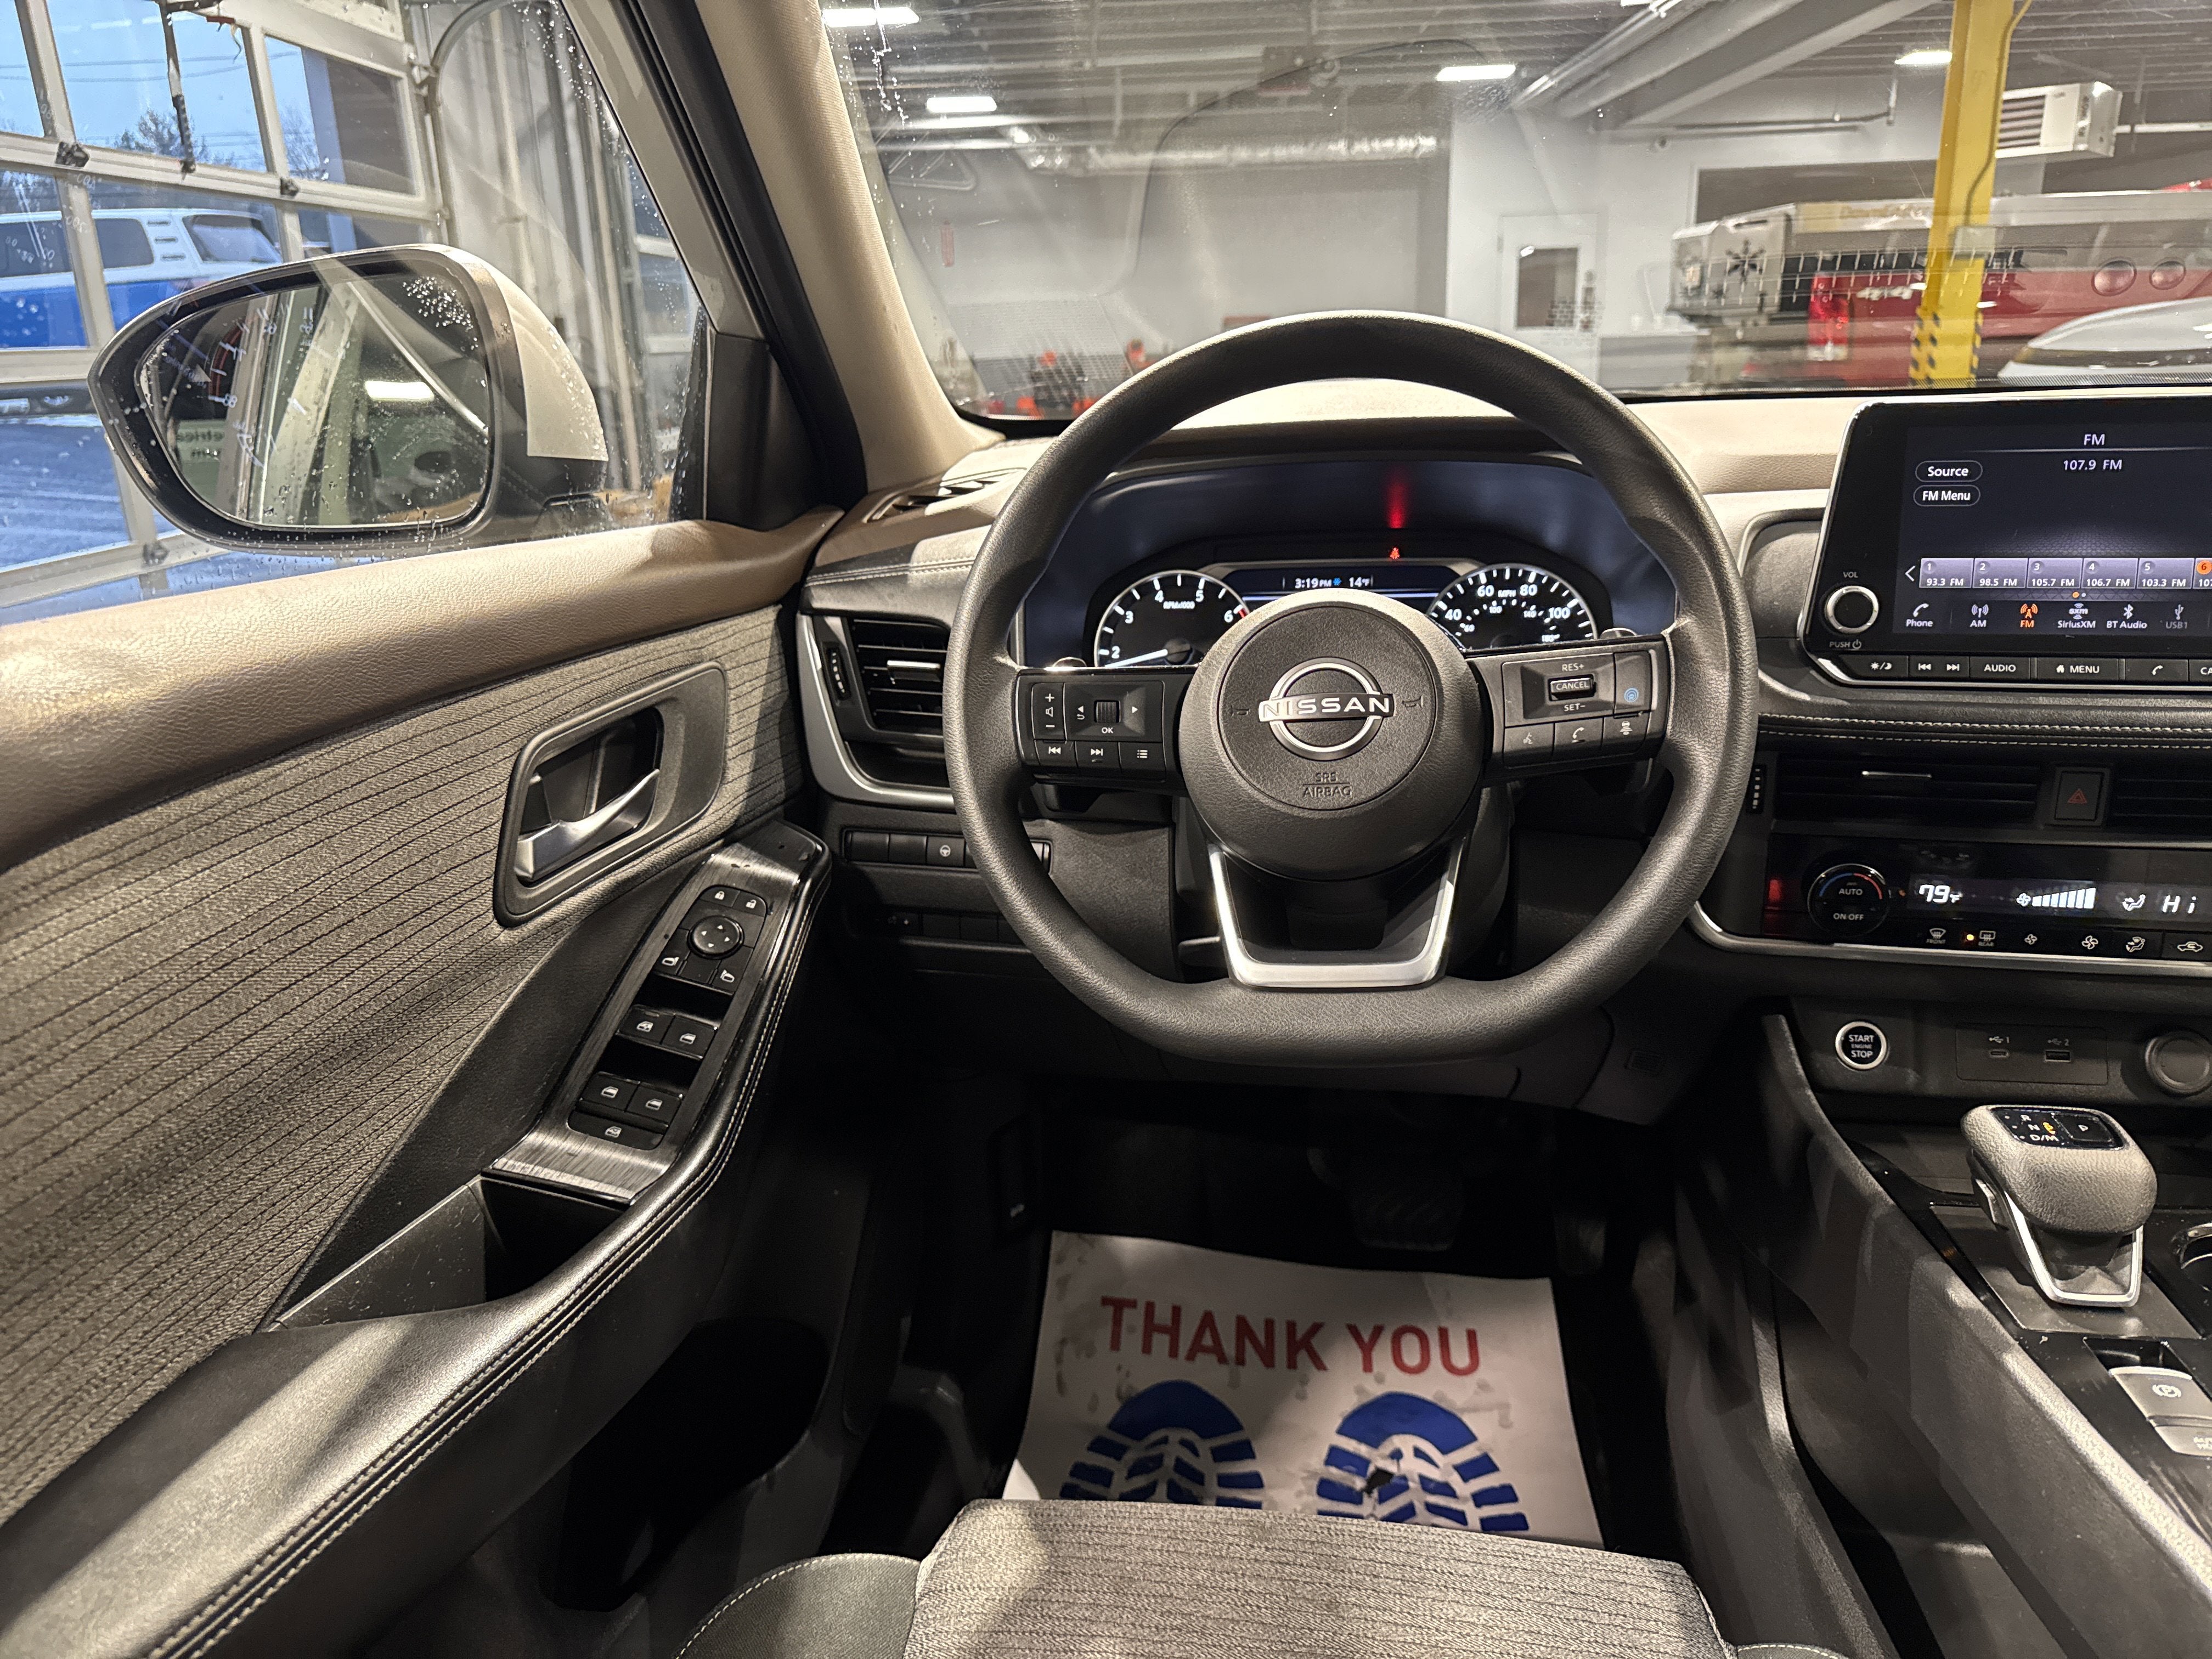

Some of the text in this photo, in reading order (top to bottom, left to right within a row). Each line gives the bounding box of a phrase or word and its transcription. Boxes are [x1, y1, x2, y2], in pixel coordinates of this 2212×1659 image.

[2084, 434, 2105, 445] FM
[2063, 459, 2123, 471] 107.9 FM
[1927, 466, 1969, 477] Source
[1922, 490, 1971, 501] FM Menu
[1926, 578, 1946, 586] 93.3
[1979, 578, 2017, 586] 98.5 FM
[2032, 578, 2075, 586] 105.7 FM
[2086, 578, 2111, 586] 106.7
[1477, 585, 1494, 597] 60
[1498, 589, 1516, 597] MPH
[1519, 584, 1538, 596] 80
[1154, 590, 1164, 602] 4
[1195, 590, 1204, 602] 5
[1444, 608, 1462, 620] 40
[1489, 606, 1503, 614] 100
[1523, 610, 1537, 618] 140
[1548, 607, 1571, 619] 100
[1125, 611, 1133, 624] 3
[1224, 610, 1233, 623] 6
[1906, 619, 1933, 627] Phone
[2057, 620, 2096, 628] SiriusXM
[2106, 620, 2147, 629] BT Audio
[2165, 621, 2188, 629] USB1
[1111, 646, 1120, 659] 2
[1984, 664, 2016, 673] AUDIO
[2070, 665, 2100, 674] MENU
[1556, 680, 1589, 691] CANCEL
[1263, 697, 1390, 718] NISSAN
[1316, 772, 1338, 782] SRS
[1303, 786, 1353, 797] AIRBAG
[1848, 913, 1864, 921] OFF
[1848, 1034, 1874, 1042] START
[1851, 1050, 1874, 1058] STOP
[2030, 1133, 2059, 1142] D/M
[1101, 1295, 1481, 1376] THANK YOU
